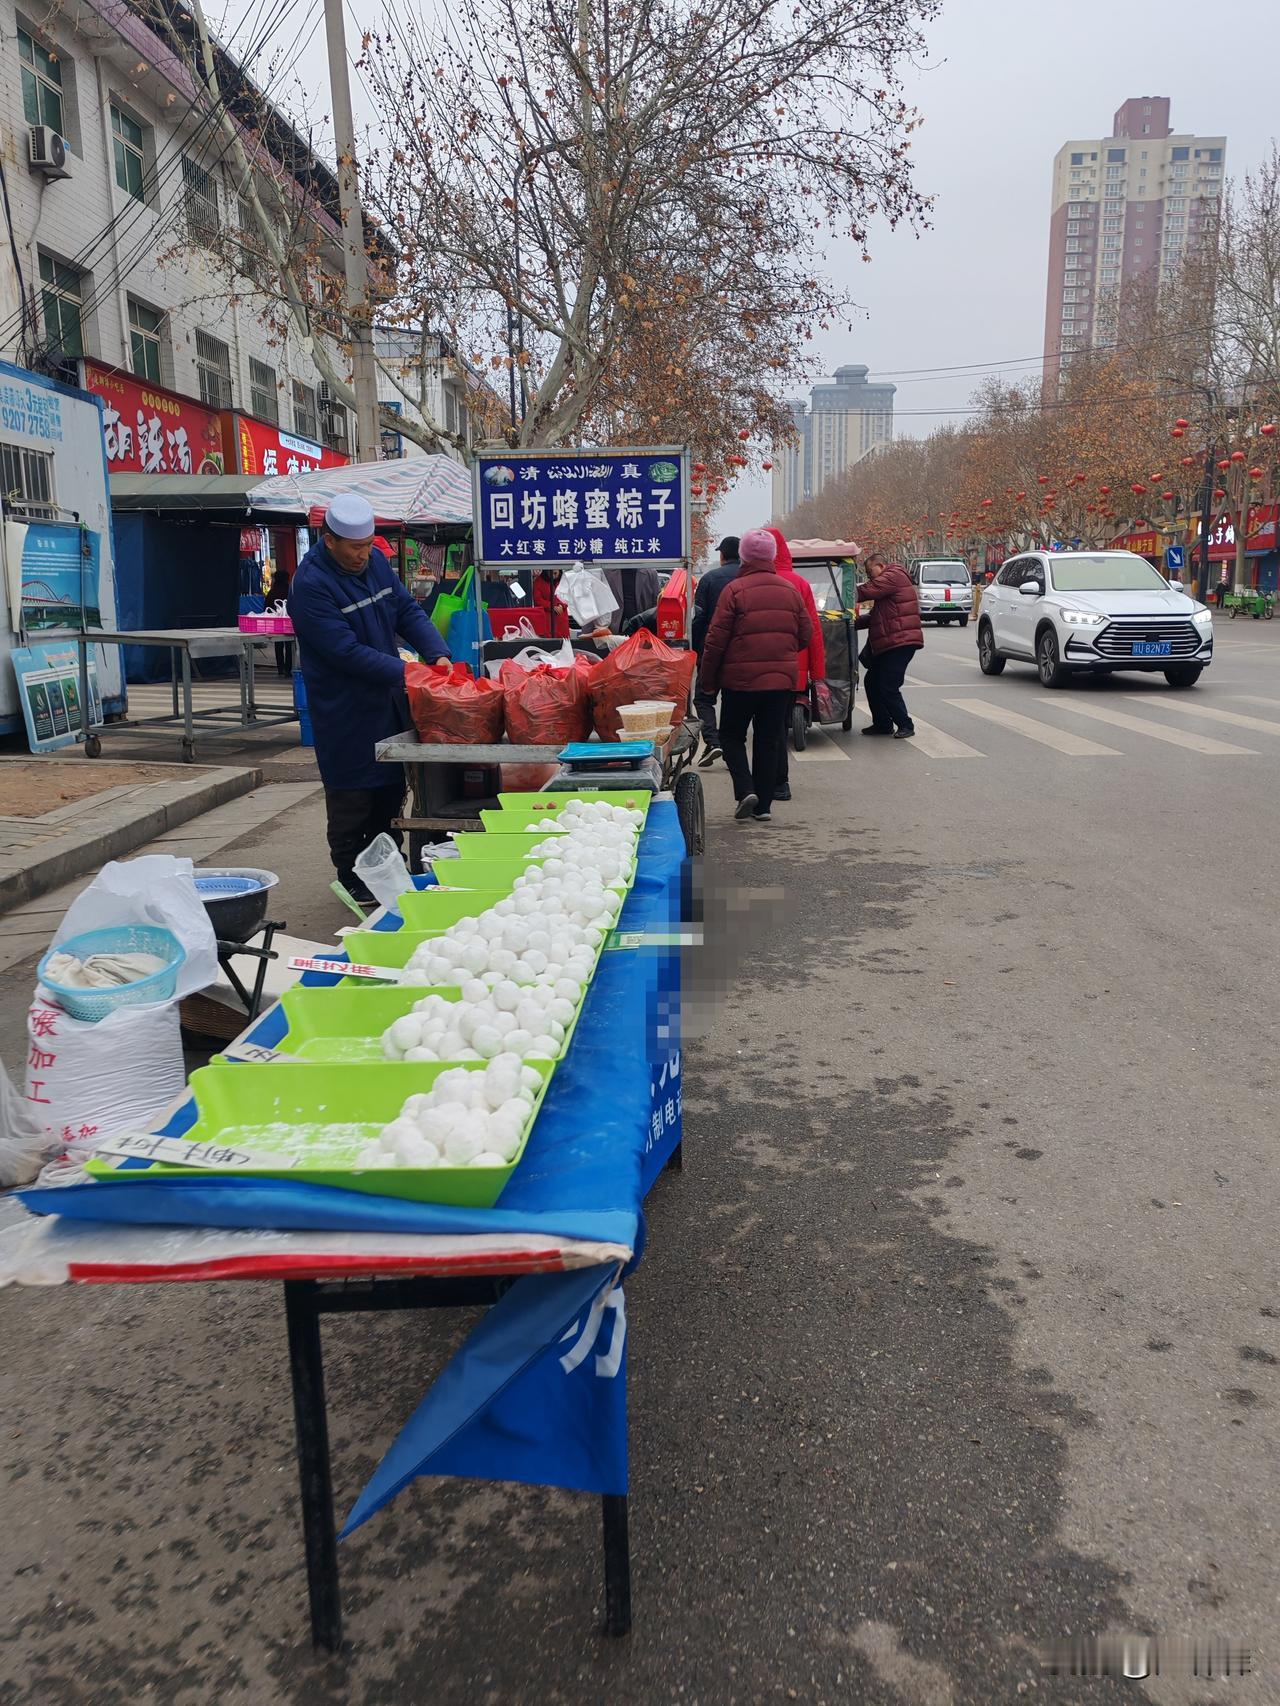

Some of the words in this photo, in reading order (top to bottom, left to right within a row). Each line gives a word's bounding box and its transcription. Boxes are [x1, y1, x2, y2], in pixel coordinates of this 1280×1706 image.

[2, 406, 25, 432] 9207
[28, 413, 50, 439] 2758
[519, 466, 540, 481] 清
[620, 463, 643, 479] 真
[489, 487, 675, 530] 回坊蜂蜜粽子
[500, 539, 546, 556] 大红枣
[558, 538, 604, 555] 豆沙糖
[615, 537, 662, 554] 纯江米
